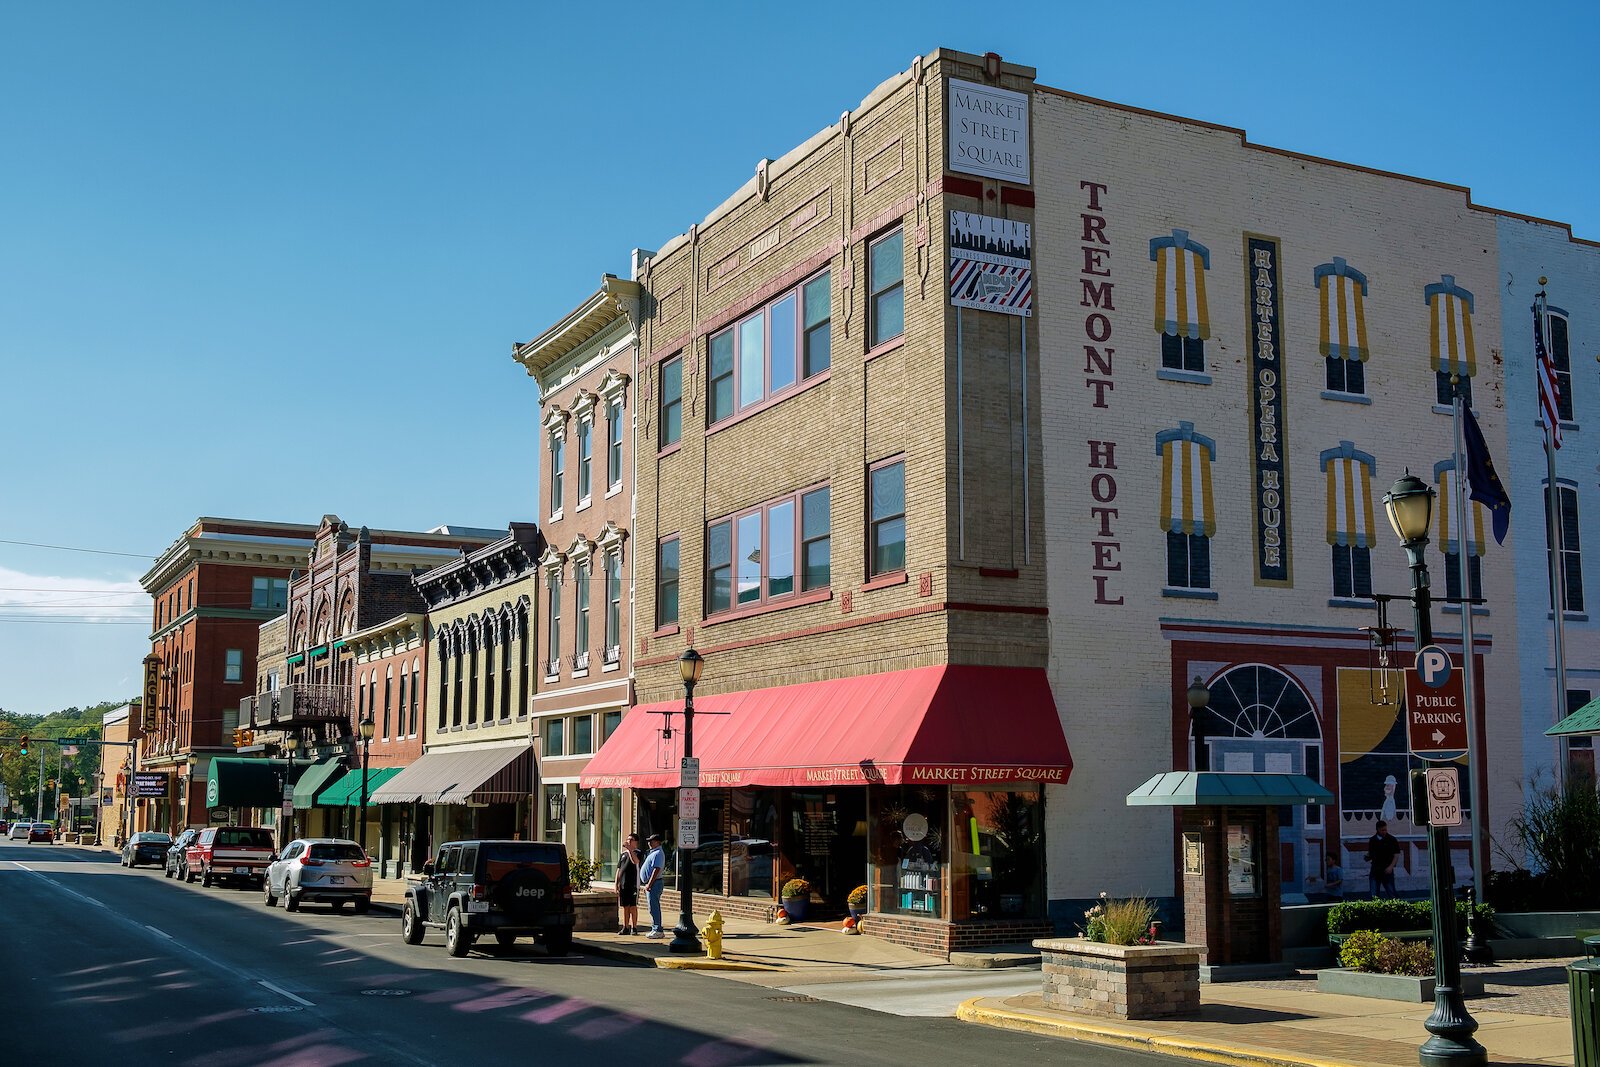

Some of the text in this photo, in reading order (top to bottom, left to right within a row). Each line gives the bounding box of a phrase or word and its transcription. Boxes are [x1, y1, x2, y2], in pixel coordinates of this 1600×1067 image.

[955, 91, 1024, 120] MARKET
[960, 118, 1019, 143] STREET
[957, 141, 1023, 168] SQUARE
[952, 210, 1029, 238] SKYLINE
[952, 249, 980, 259] BUSINESS
[1080, 180, 1124, 605] TREMONT HOTEL
[1254, 249, 1281, 568] HARTER OPERA HOUSE
[1423, 652, 1446, 682] P
[146, 661, 157, 731] EAGLES
[1416, 695, 1457, 707] PUBLIC
[1413, 711, 1462, 724] PARKING
[701, 773, 720, 783] STREET
[719, 771, 741, 784] SQUARE
[806, 768, 887, 781] MARKET STREET SQUARE
[912, 766, 1063, 780] MARKET STREET SQUARE
[1435, 805, 1457, 819] STOP
[515, 886, 545, 899] Jeep
